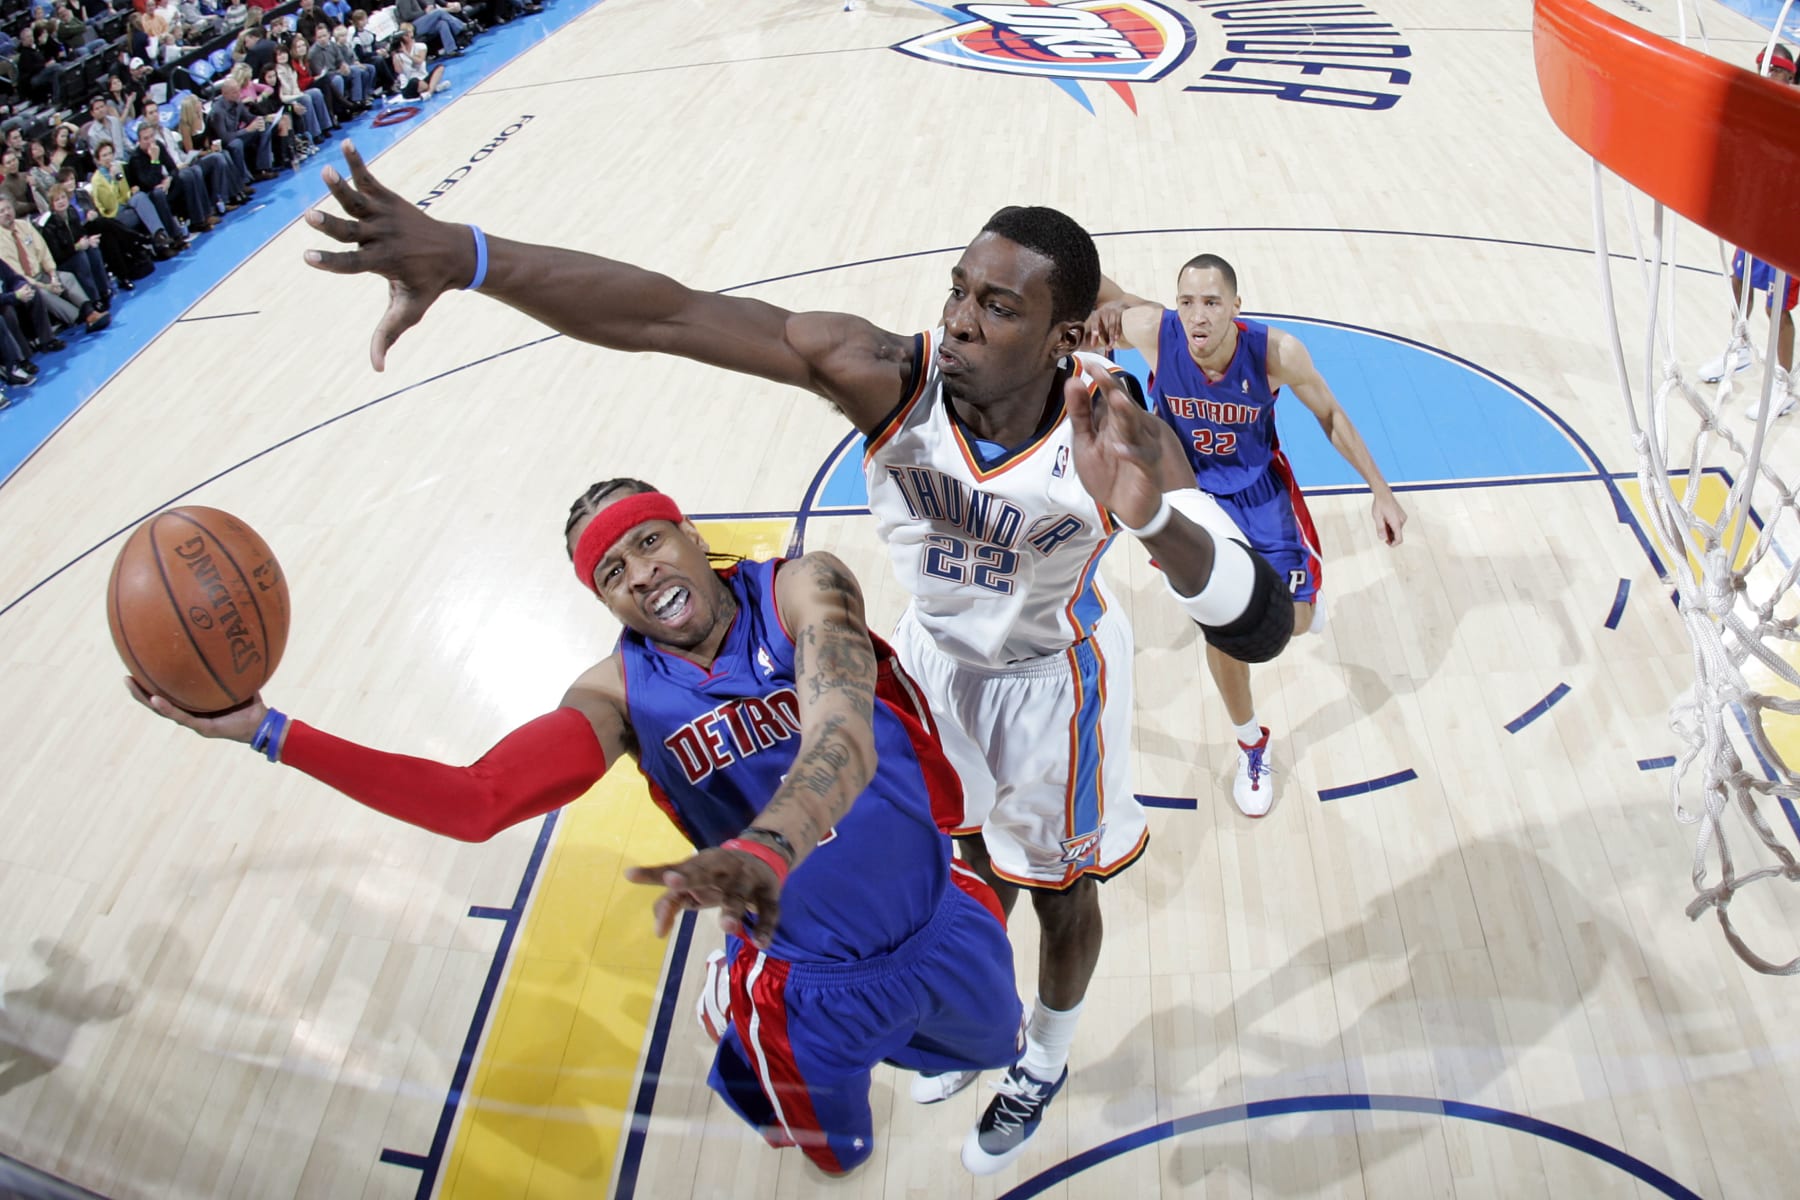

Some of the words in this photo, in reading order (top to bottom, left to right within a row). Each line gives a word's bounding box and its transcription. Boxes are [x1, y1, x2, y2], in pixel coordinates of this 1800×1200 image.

[953, 3, 1144, 59] OKC
[1182, 0, 1412, 110] UNDER
[470, 114, 535, 163] FORD
[416, 165, 472, 211] CEN
[1164, 394, 1262, 425] DETROIT
[1191, 428, 1237, 456] 22
[885, 464, 1086, 558] THUNDR
[922, 532, 1020, 596] 22
[174, 535, 262, 676] SPALDING
